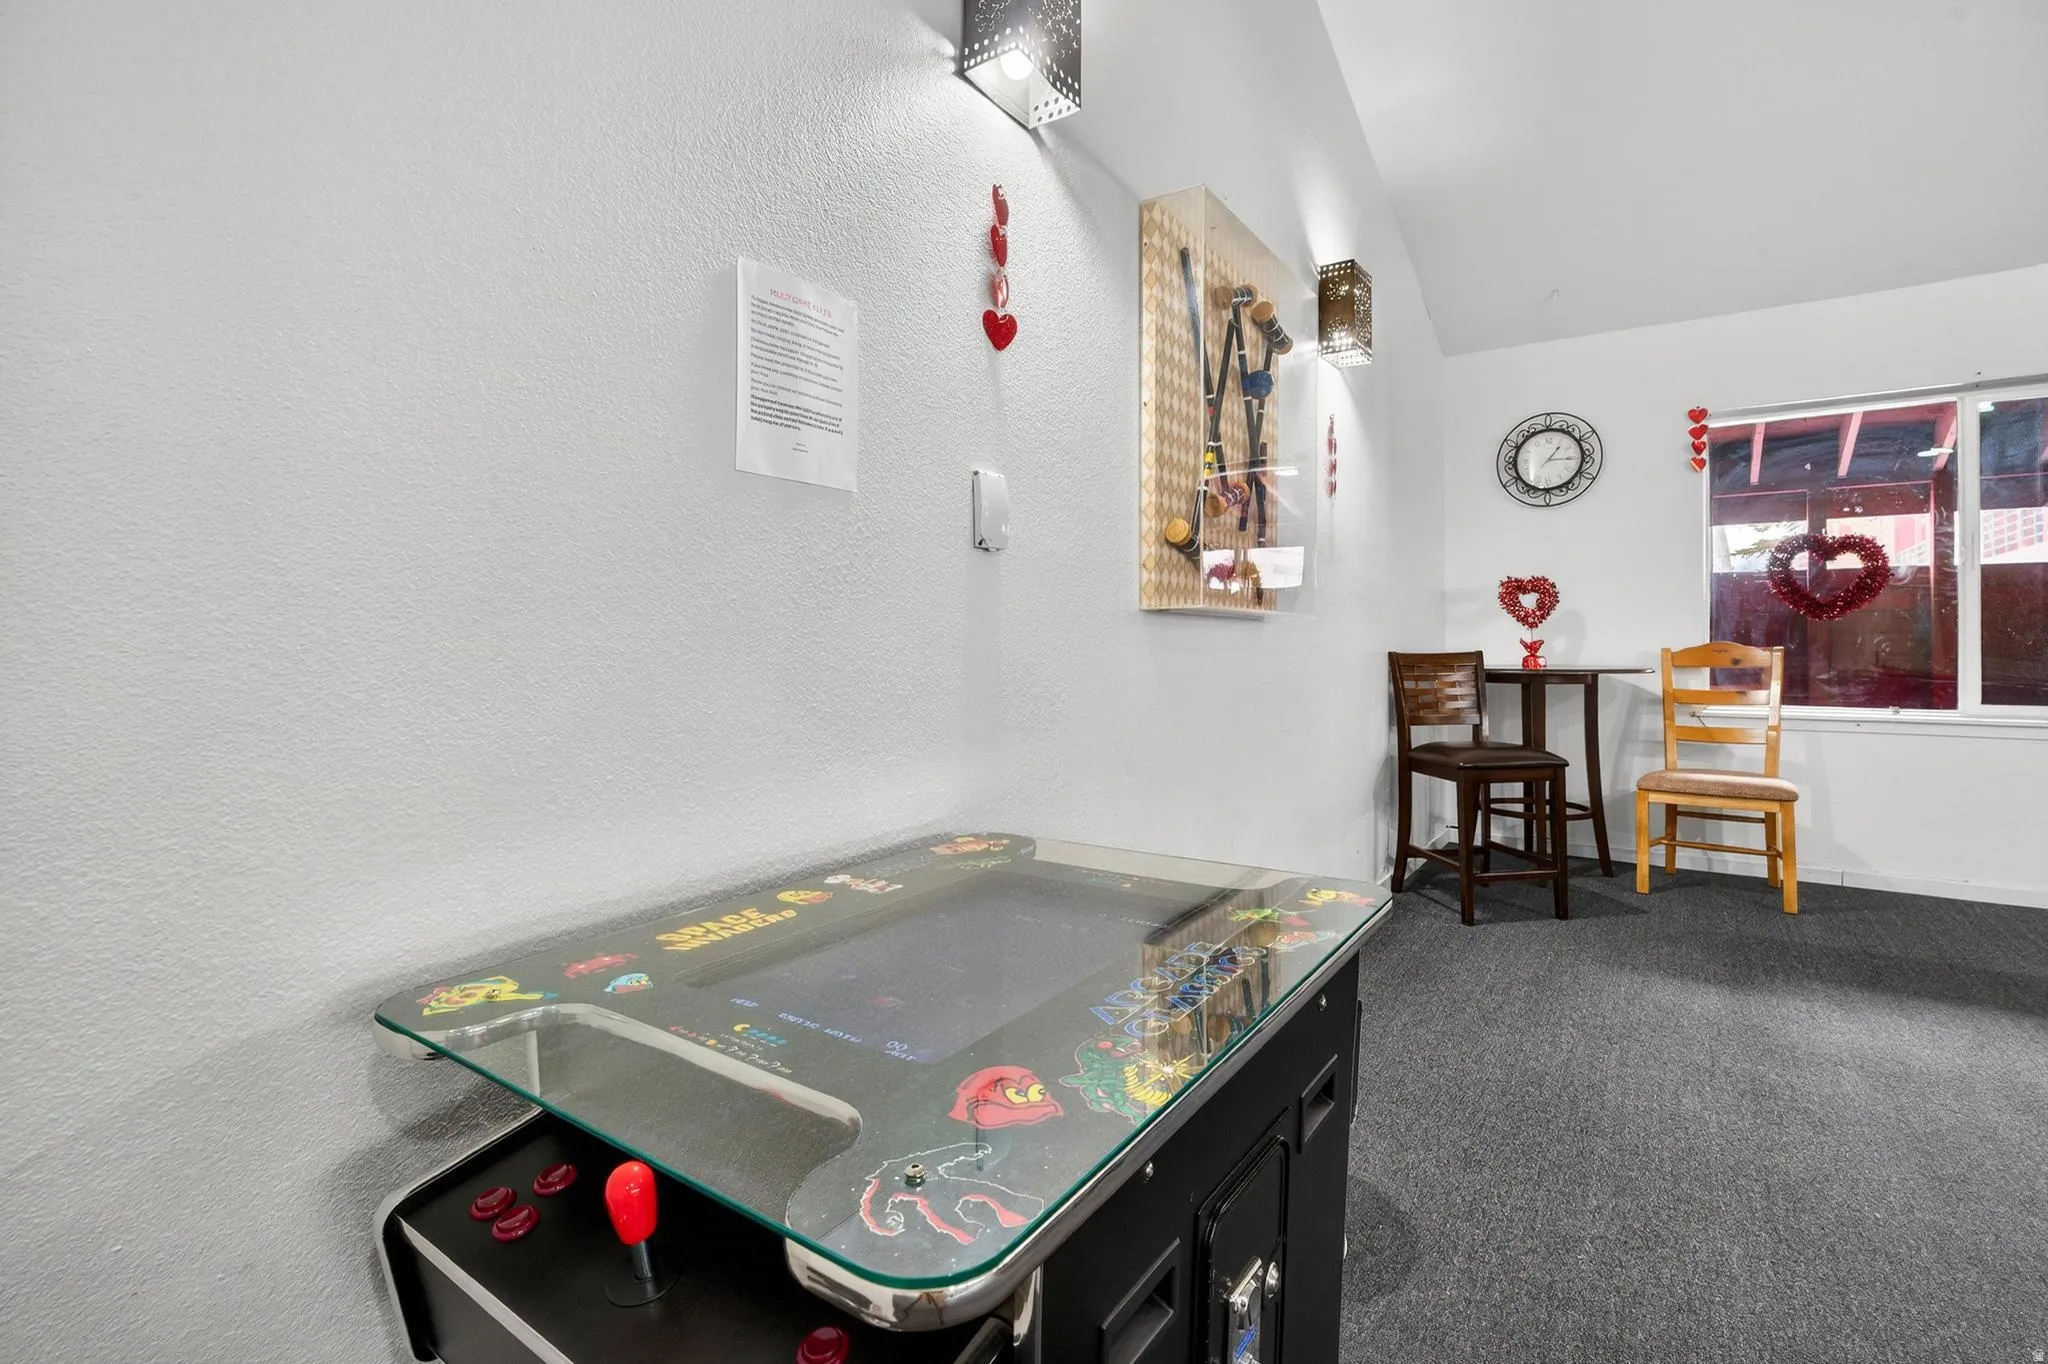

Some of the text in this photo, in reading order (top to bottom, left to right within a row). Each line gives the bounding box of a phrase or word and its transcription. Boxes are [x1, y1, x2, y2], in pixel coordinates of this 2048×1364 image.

[656, 907, 768, 941] SPACE
[661, 909, 797, 950] INVADERS
[1089, 941, 1228, 1025] ARCADE
[1124, 946, 1268, 1037] CLASSICS
